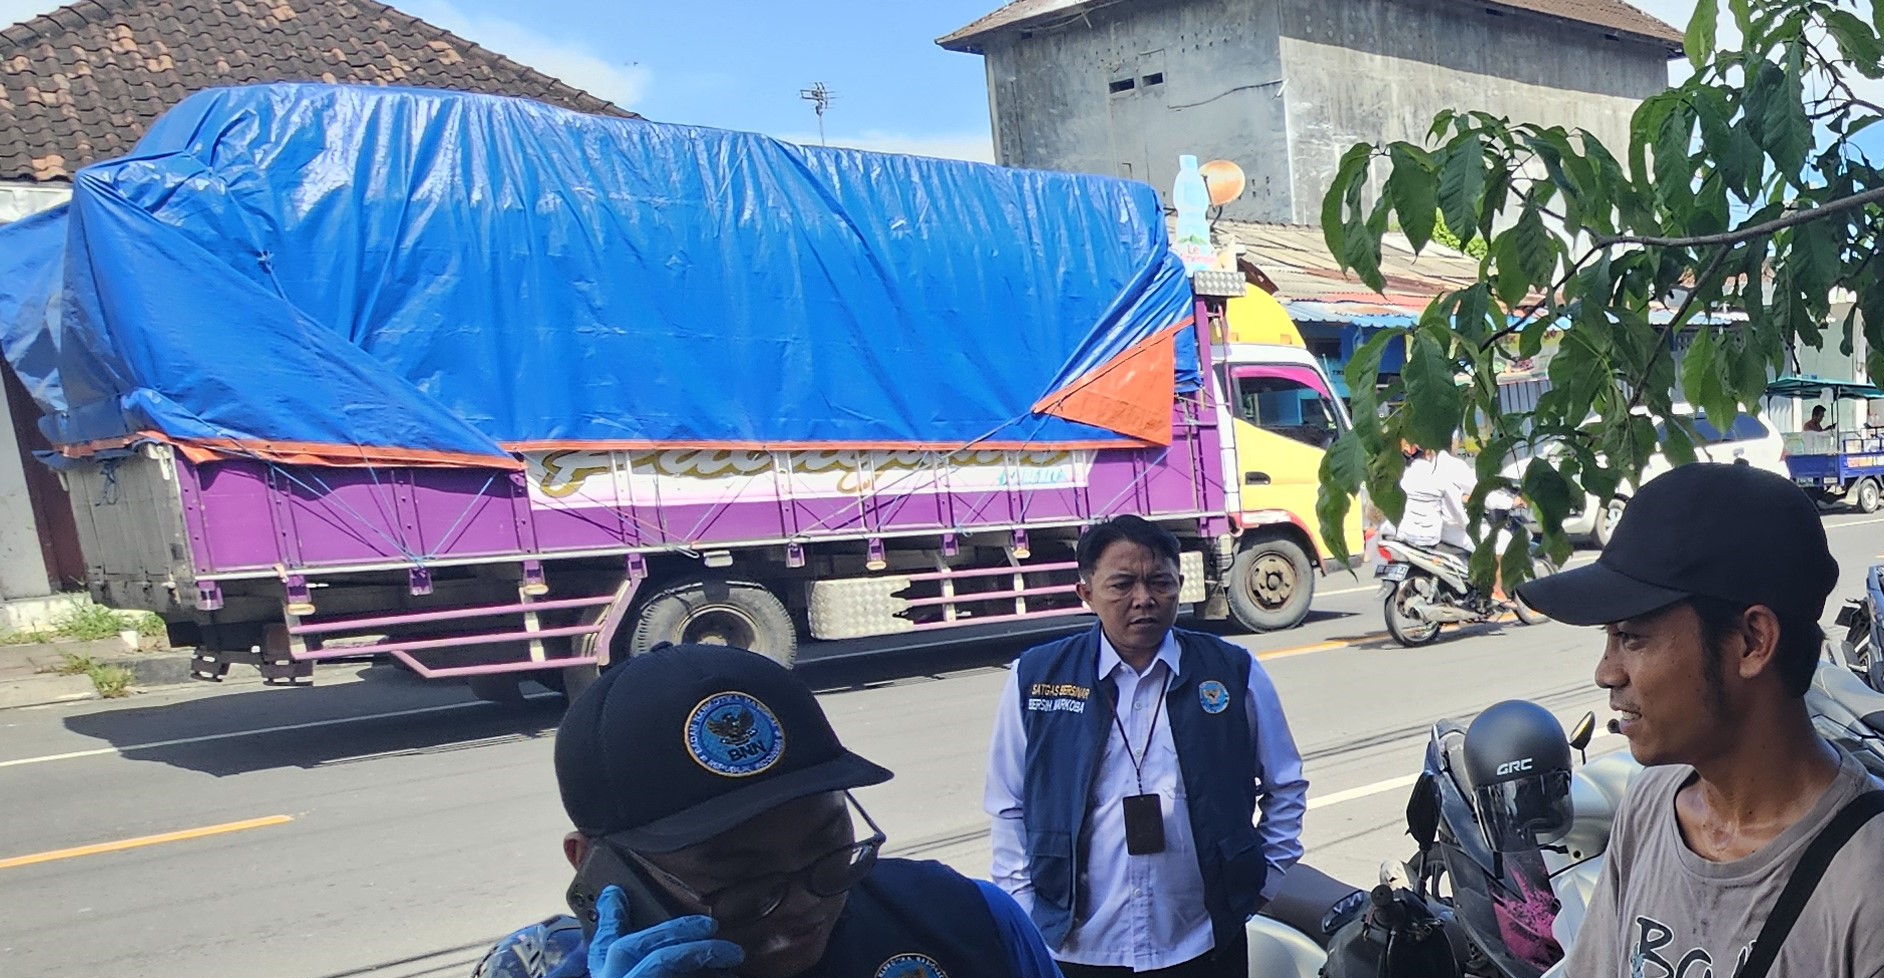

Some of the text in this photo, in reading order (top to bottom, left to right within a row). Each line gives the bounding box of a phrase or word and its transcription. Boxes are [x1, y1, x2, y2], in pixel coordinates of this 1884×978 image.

[1031, 683, 1060, 697] SATGAS
[727, 740, 767, 762] BNN
[1496, 757, 1533, 776] GRC
